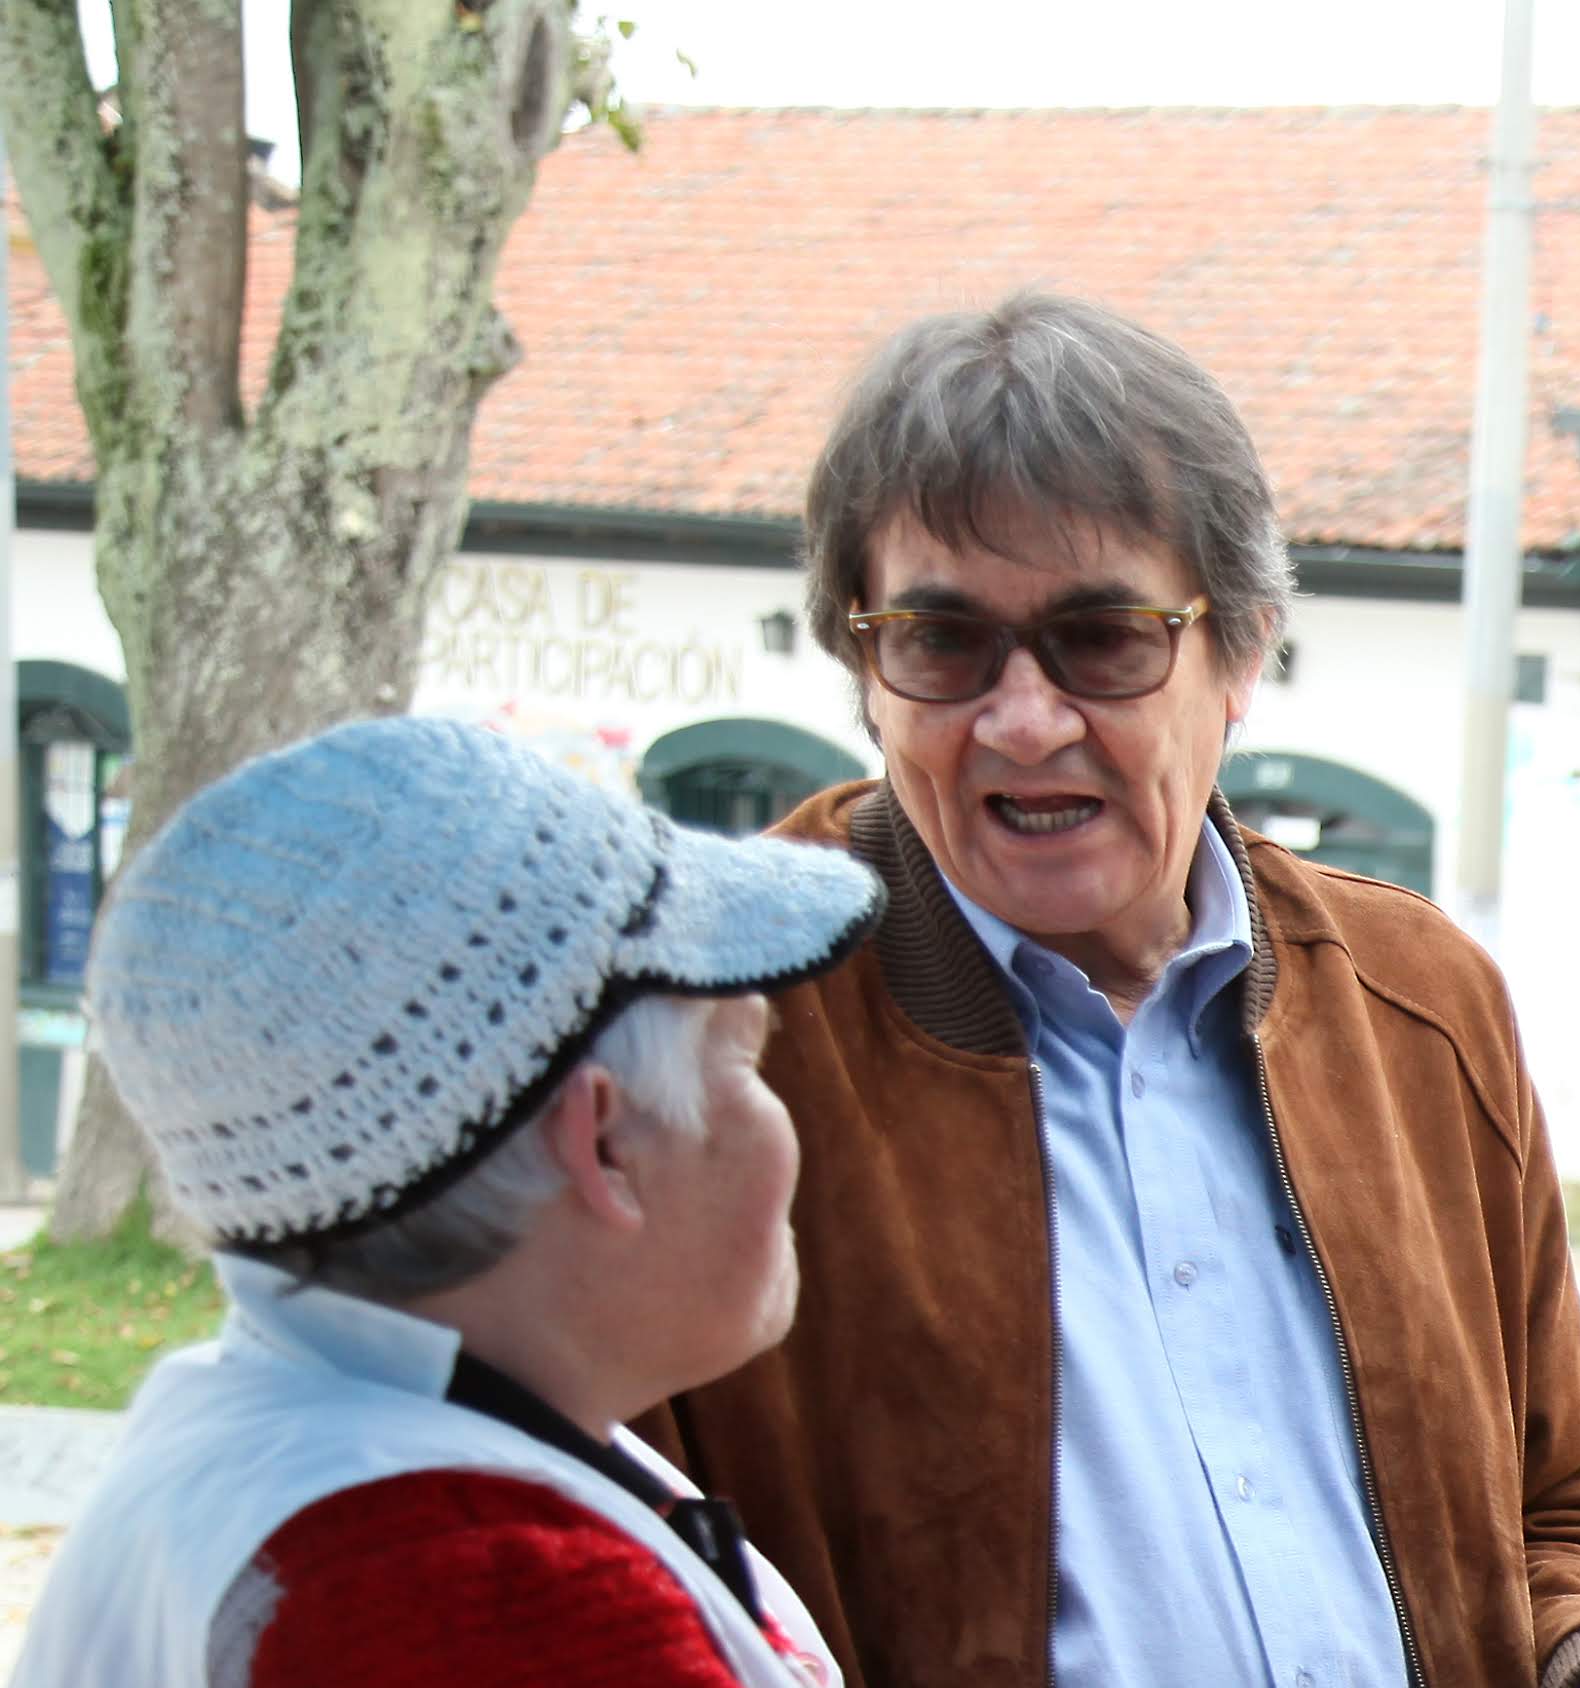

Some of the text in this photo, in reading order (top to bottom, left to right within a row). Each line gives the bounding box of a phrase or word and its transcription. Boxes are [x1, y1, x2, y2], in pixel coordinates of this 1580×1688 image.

[432, 564, 640, 638] CASA DE
[421, 625, 744, 702] PARTICIPACIÓN
